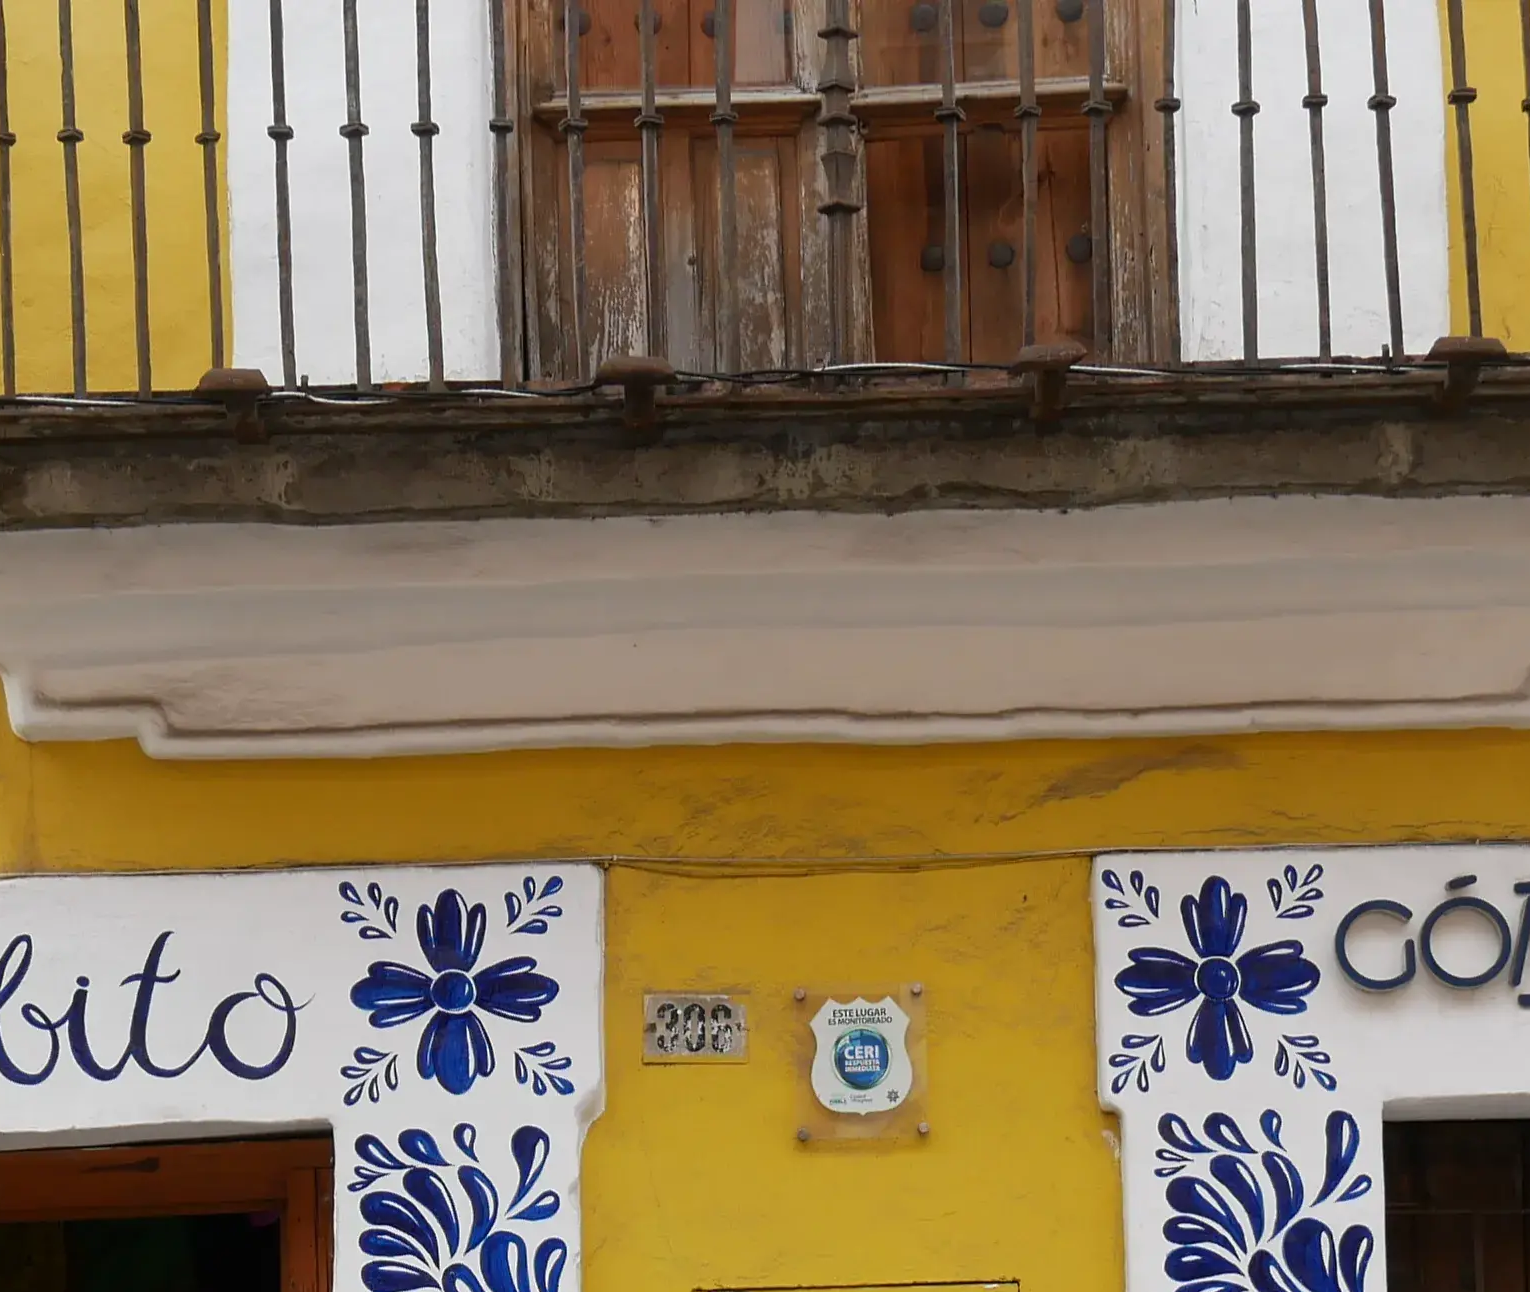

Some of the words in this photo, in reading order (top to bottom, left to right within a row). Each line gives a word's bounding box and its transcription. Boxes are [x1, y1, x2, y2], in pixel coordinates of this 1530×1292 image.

[832, 1008, 854, 1018] ESTE
[856, 1007, 887, 1018] LUGAR
[656, 1002, 733, 1053] 306
[828, 1018, 837, 1026] ES
[838, 1016, 893, 1026] MONITOREADO
[844, 1045, 880, 1060] CERI
